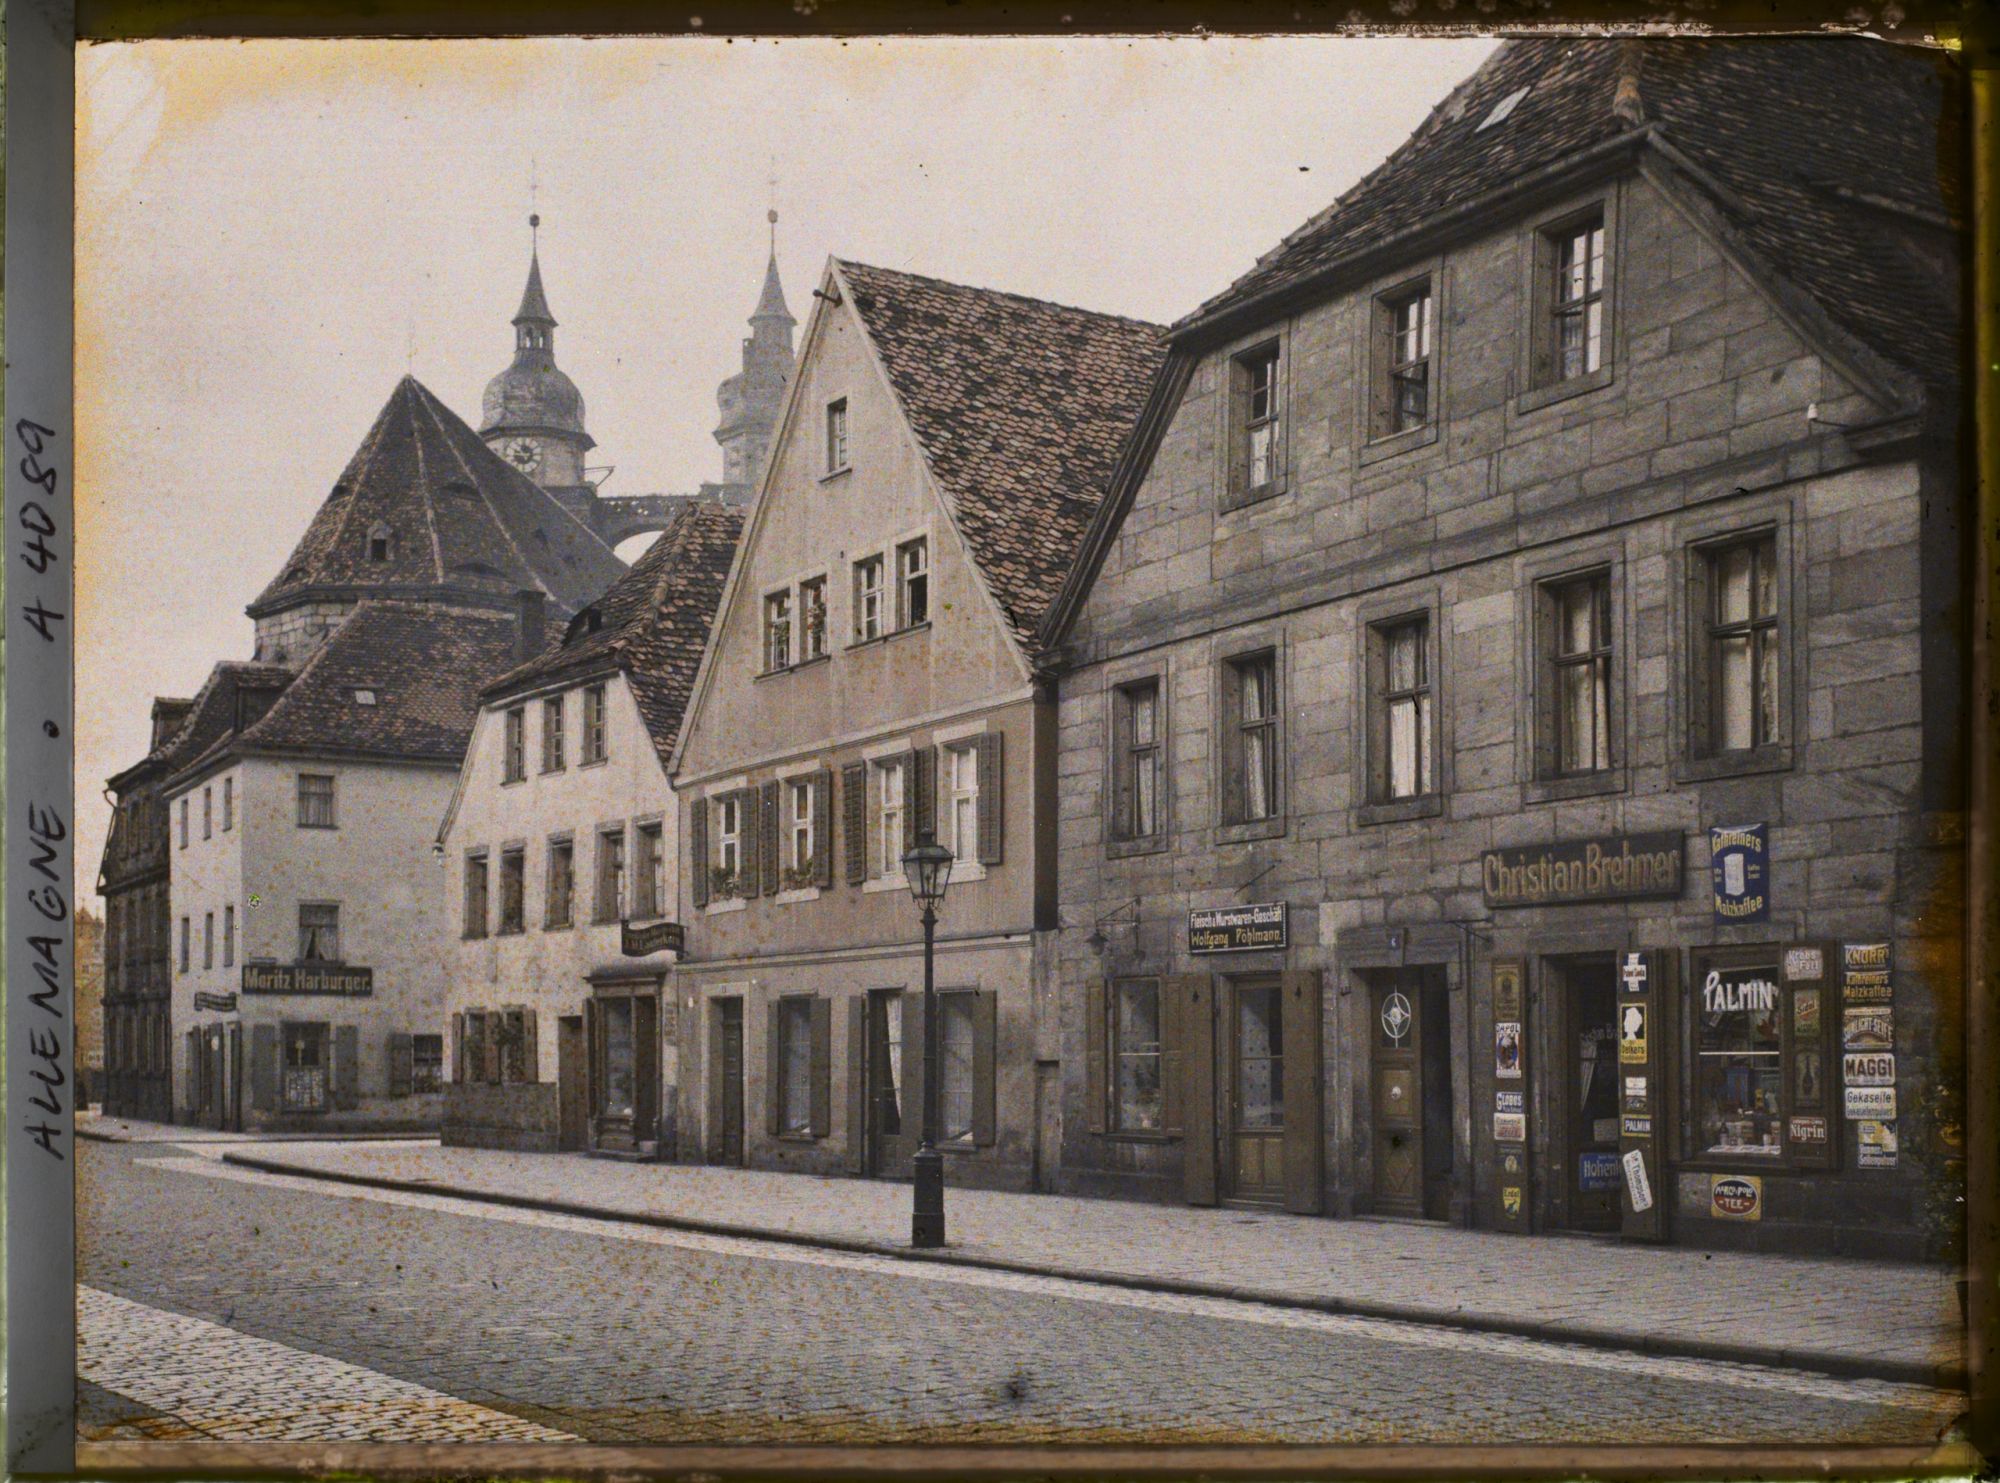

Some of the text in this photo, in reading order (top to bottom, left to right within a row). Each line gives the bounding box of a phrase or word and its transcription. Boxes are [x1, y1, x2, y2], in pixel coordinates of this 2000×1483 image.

[1711, 831, 1762, 856] Kathreiners
[1484, 841, 1680, 897] Christian Brehmer
[1715, 893, 1763, 917] Malzkaffee
[1190, 912, 1212, 929] Fleisch
[1191, 931, 1229, 949] Wolfgang
[23, 801, 67, 1160] ALLEMAGNE
[244, 968, 291, 990] Moritz
[1846, 974, 1889, 985] Kathreiners
[1844, 985, 1893, 998] Malzkaffee
[1845, 1058, 1893, 1077] MAGGI
[1847, 1091, 1892, 1104] Gekaseife
[1624, 1120, 1651, 1132] PALMIN
[1791, 1123, 1825, 1141] Nigrin
